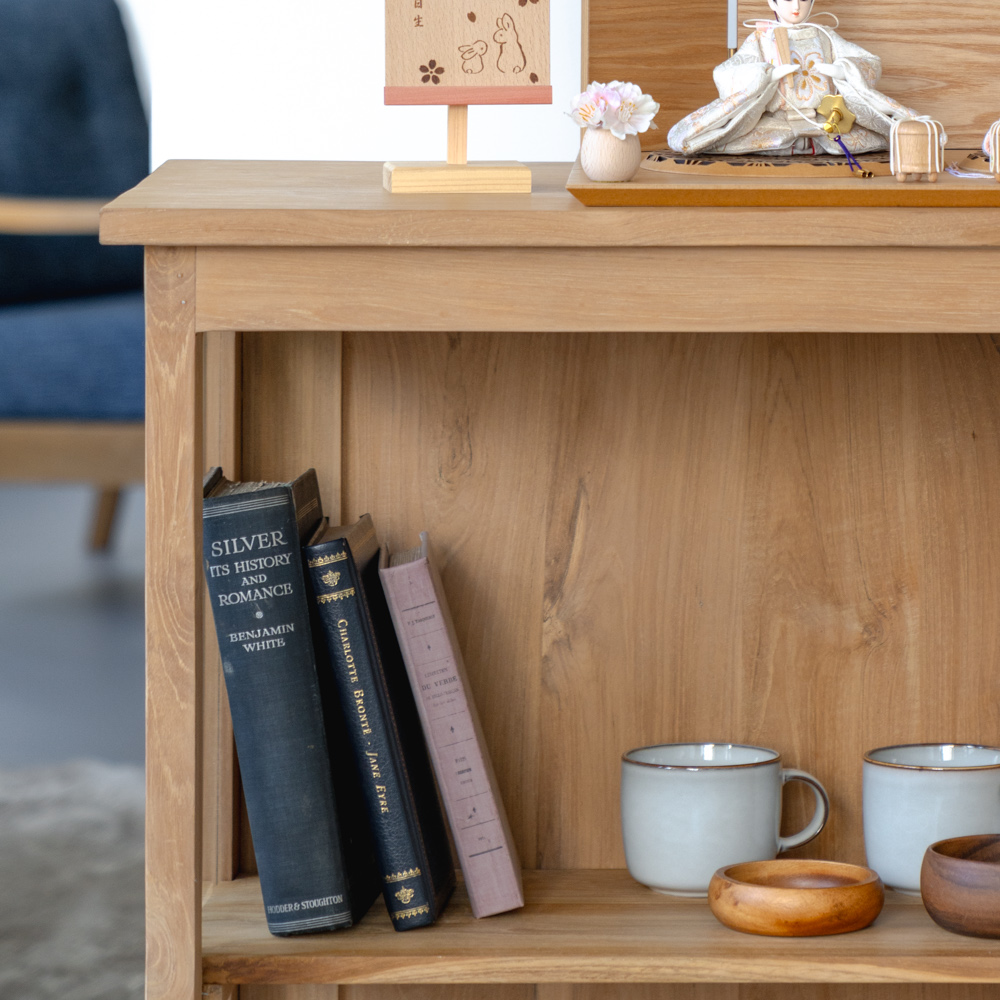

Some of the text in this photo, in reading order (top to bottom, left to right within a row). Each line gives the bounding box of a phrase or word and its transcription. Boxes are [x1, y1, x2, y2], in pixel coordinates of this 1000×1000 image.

[211, 531, 288, 557] SILVER
[210, 553, 292, 577] ITS HISTORY
[241, 574, 267, 586] AND
[218, 583, 293, 606] ROMANCE
[229, 623, 295, 642] BENJAMIN
[242, 638, 286, 652] WHITE
[337, 619, 358, 683] CHARLOTTE
[365, 751, 381, 778] JANE
[375, 785, 389, 813] EYRE
[267, 903, 293, 914] HODDER
[301, 894, 343, 910] STOUGHTON
